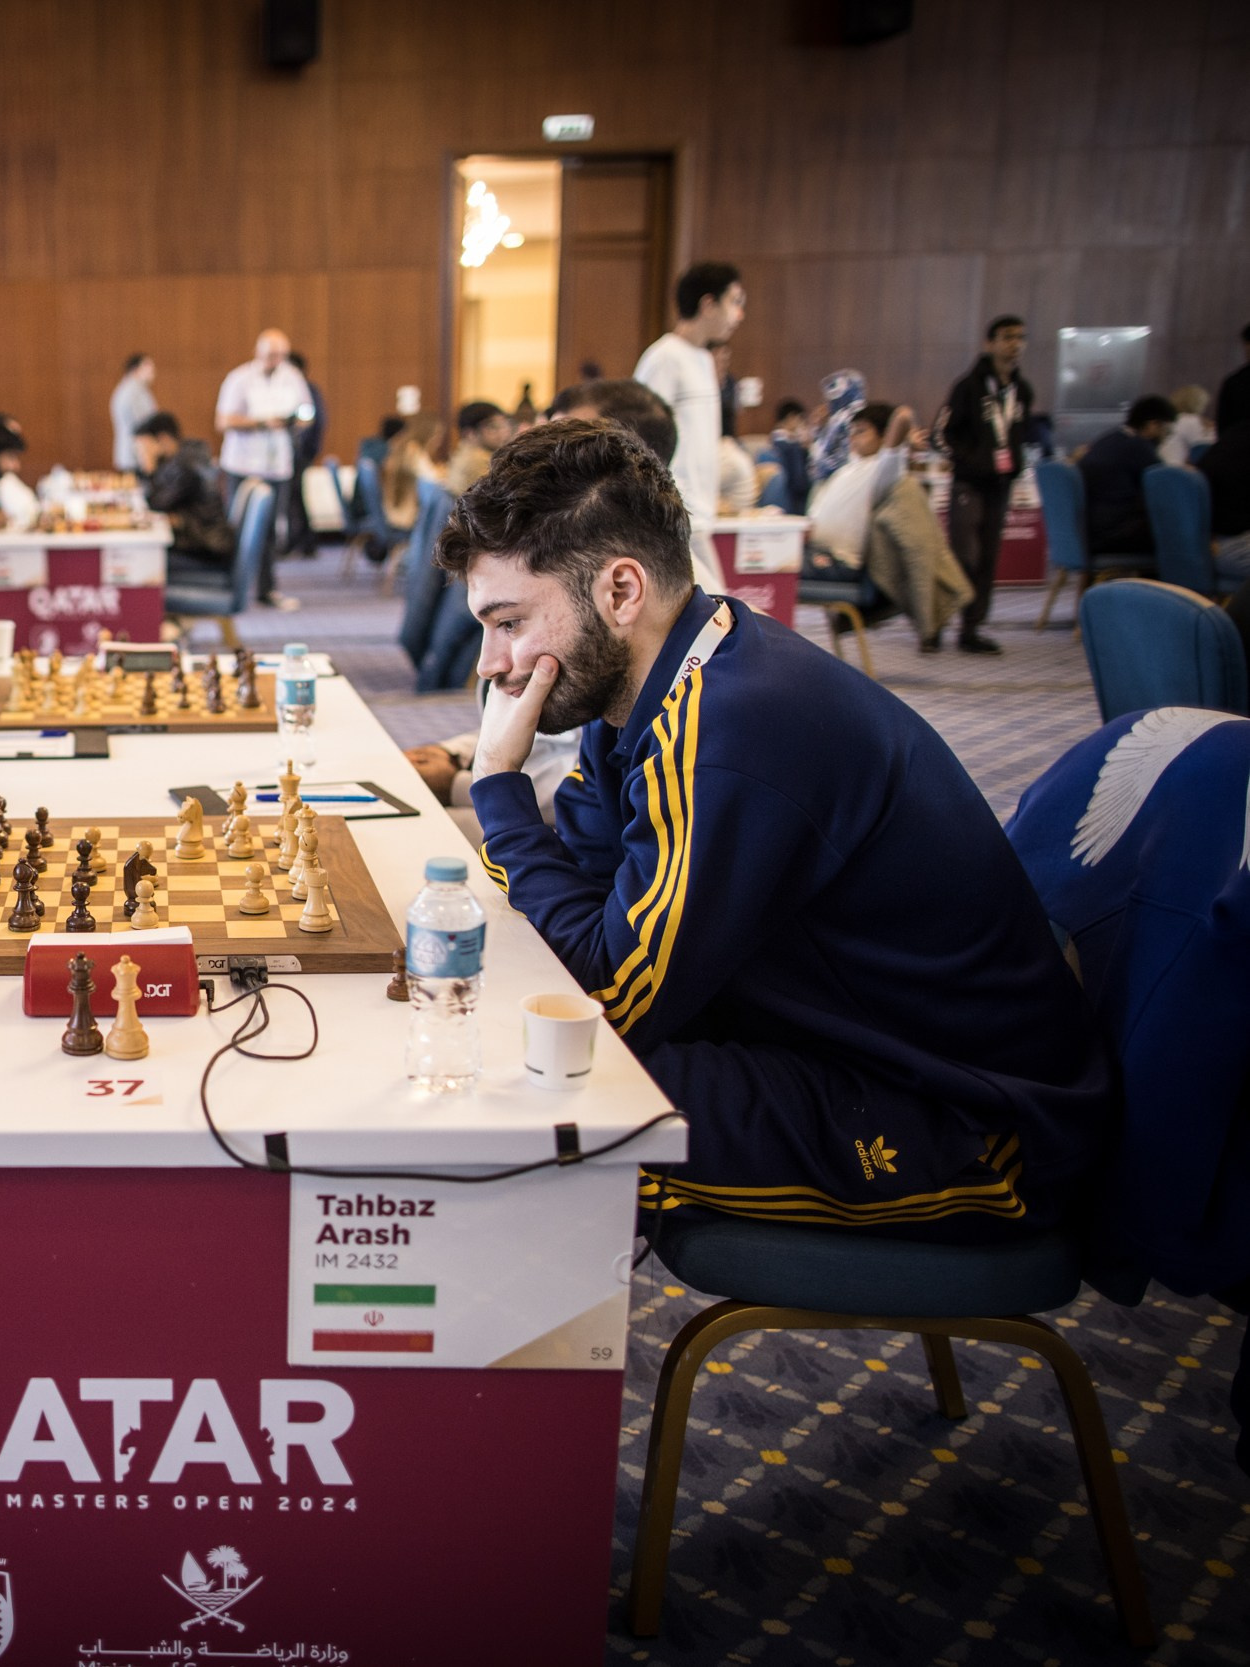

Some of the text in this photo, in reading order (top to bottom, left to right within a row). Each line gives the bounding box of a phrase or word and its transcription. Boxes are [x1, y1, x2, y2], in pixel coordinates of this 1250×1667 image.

[208, 959, 227, 969] DGT
[147, 983, 172, 998] DGT
[86, 1079, 145, 1097] 37
[854, 1139, 876, 1181] adidas
[316, 1193, 436, 1218] Tahbaz
[315, 1222, 411, 1246] Arash
[315, 1252, 399, 1270] IM 2432
[589, 1346, 614, 1362] 59
[6, 1493, 357, 1512] MASTERS OPEN 2024
[310, 1643, 349, 1663] وزارة
